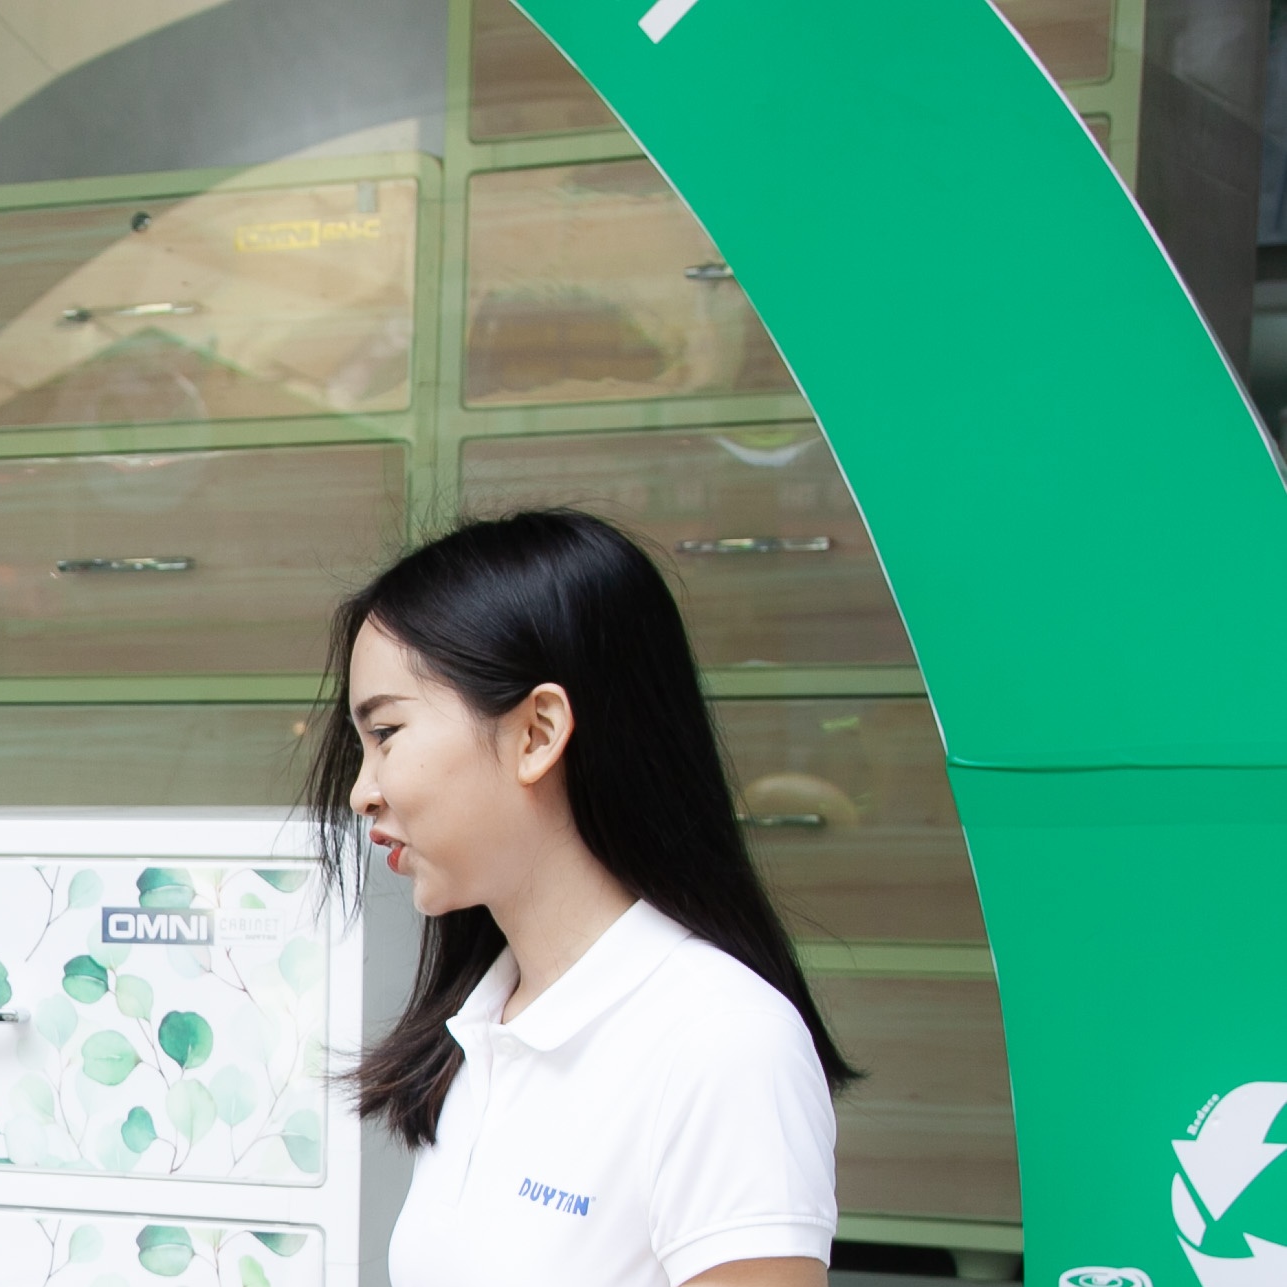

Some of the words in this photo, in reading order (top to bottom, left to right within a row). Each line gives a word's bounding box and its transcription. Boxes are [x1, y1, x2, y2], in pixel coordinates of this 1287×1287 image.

[107, 912, 209, 941] OMNI
[219, 916, 280, 933] CABINET
[1186, 1092, 1222, 1137] Reduce
[518, 1177, 590, 1217] DUYTAN
